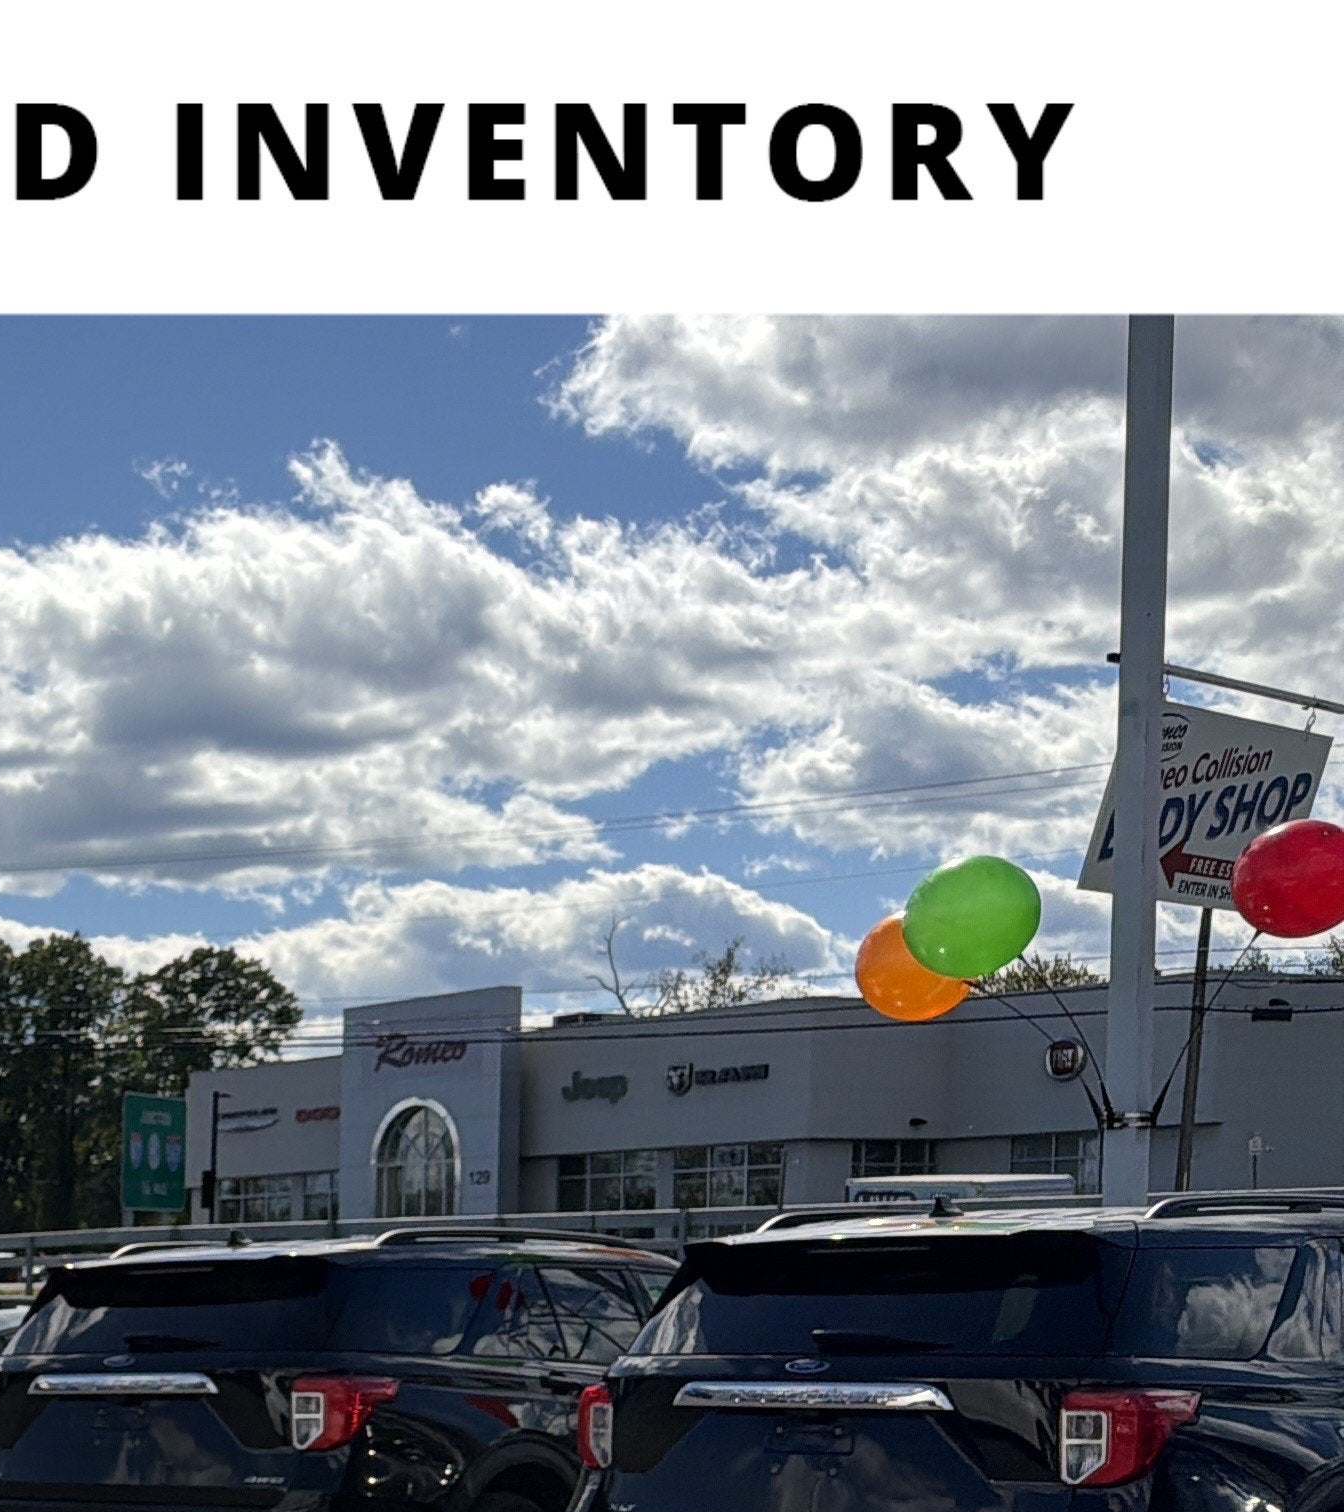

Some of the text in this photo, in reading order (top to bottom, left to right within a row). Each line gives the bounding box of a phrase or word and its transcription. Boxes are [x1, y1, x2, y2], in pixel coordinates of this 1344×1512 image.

[1192, 745, 1273, 784] Collision
[1205, 772, 1313, 841] SHOP
[1189, 857, 1217, 876] FREE
[1177, 879, 1208, 897] ENTER
[1207, 884, 1218, 900] IN
